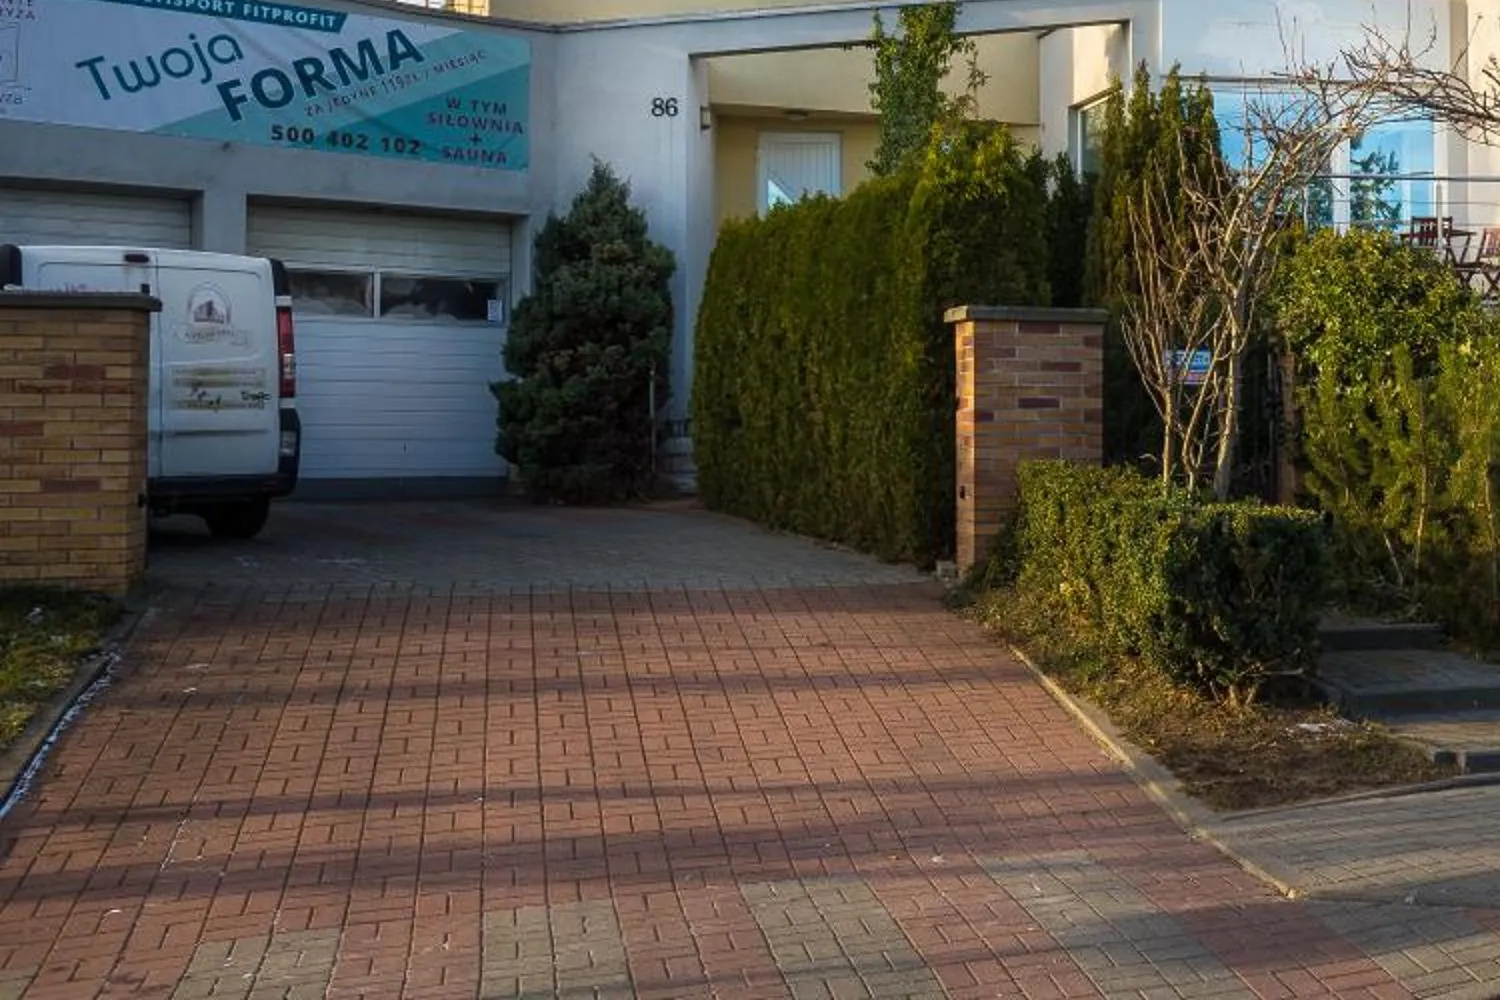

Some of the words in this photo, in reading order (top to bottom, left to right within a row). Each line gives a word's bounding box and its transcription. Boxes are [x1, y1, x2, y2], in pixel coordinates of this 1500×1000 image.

[243, 3, 337, 29] FITPROFIT
[75, 33, 244, 101] Twoja
[216, 29, 426, 121] FORMA
[445, 97, 461, 110] W
[470, 99, 508, 116] TYM
[651, 97, 679, 117] 86
[426, 111, 524, 135] SIŁOWNIA
[271, 124, 315, 144] 500
[381, 136, 422, 156] 102
[441, 145, 508, 165] SAUNA
